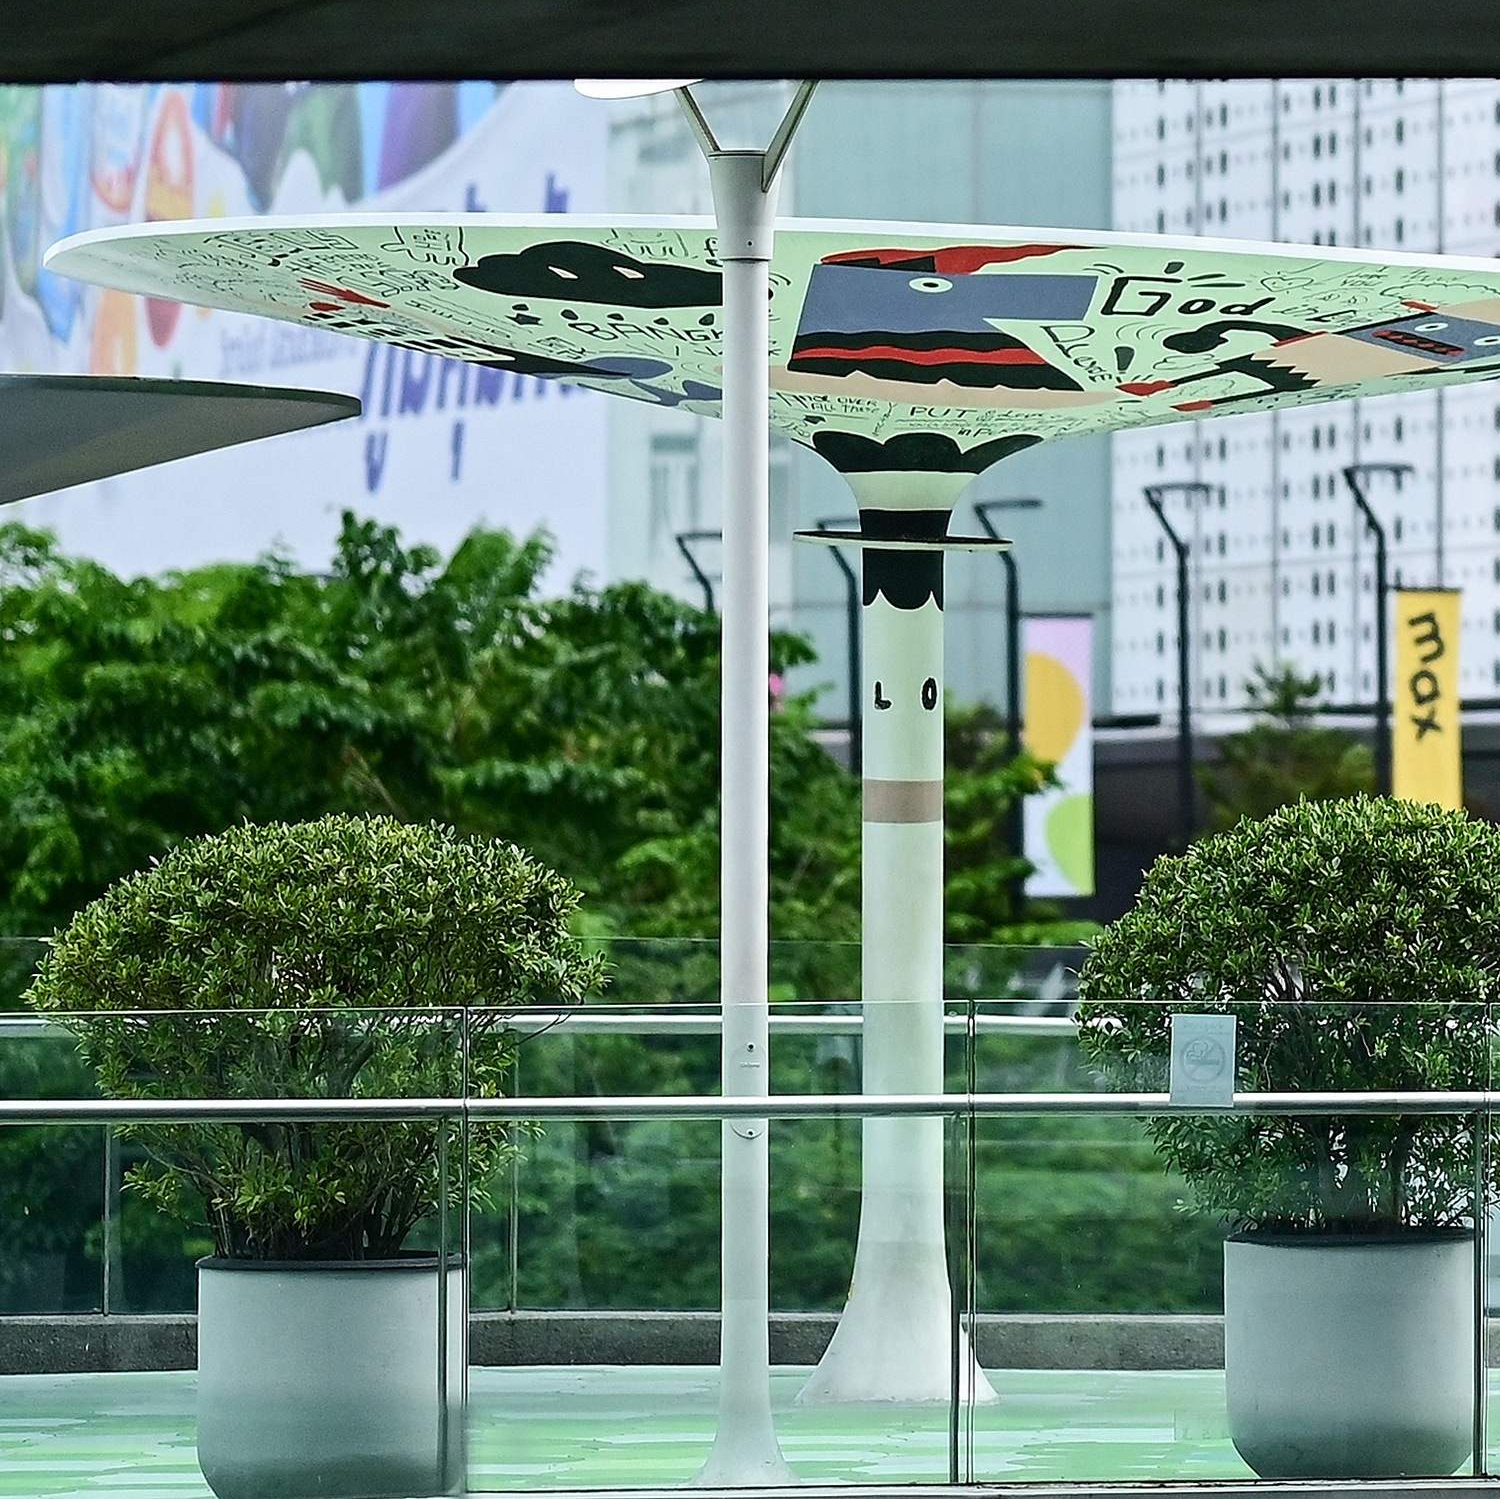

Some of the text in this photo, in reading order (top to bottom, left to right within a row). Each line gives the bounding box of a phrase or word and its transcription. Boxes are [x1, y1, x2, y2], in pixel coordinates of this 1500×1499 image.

[1100, 276, 1276, 317] God
[568, 322, 723, 342] BANGK
[909, 405, 977, 419] PUT
